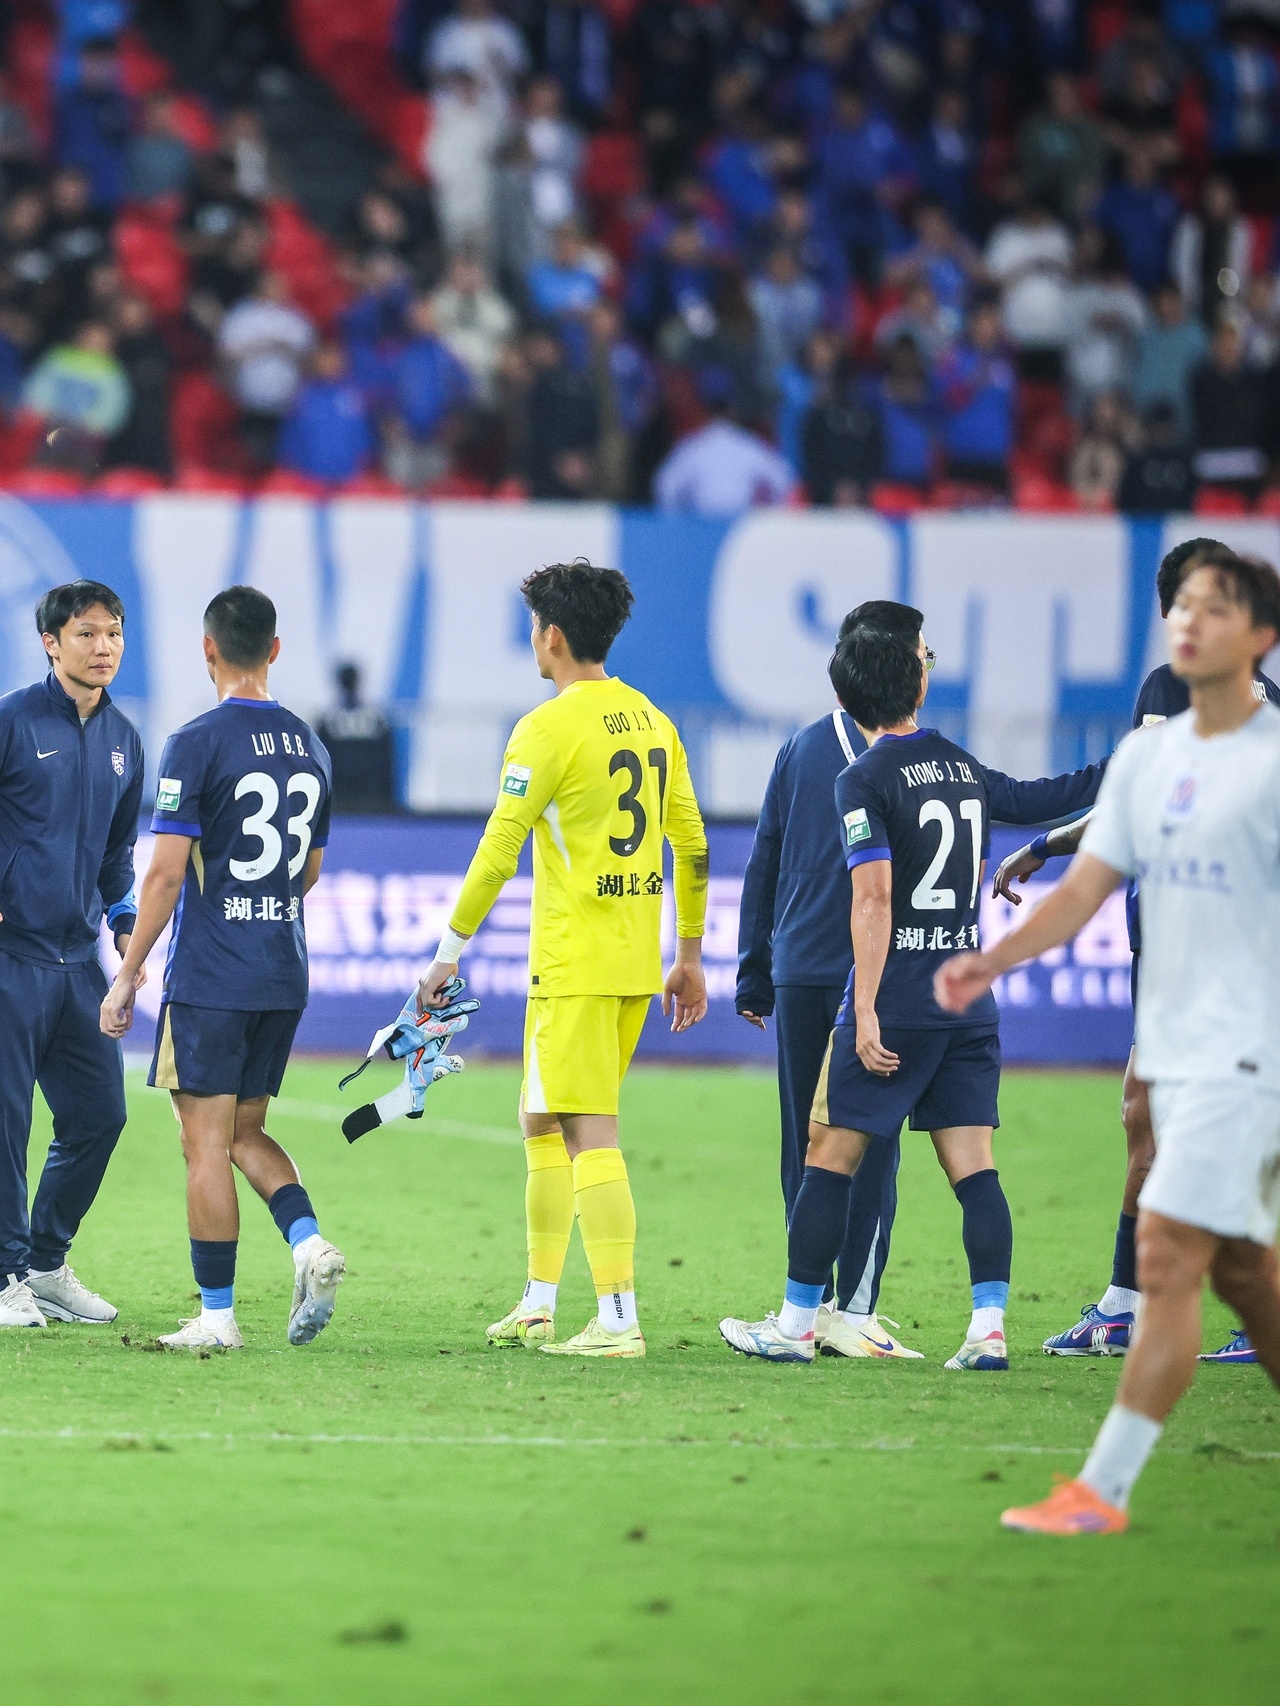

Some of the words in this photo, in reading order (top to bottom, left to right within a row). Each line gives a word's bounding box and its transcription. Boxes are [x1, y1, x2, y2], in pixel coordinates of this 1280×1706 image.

[251, 732, 275, 756] LIU
[603, 711, 631, 735] GUO
[608, 747, 668, 858] 31
[900, 760, 945, 788] XIONG
[228, 771, 321, 882] 33
[910, 798, 982, 910] 21
